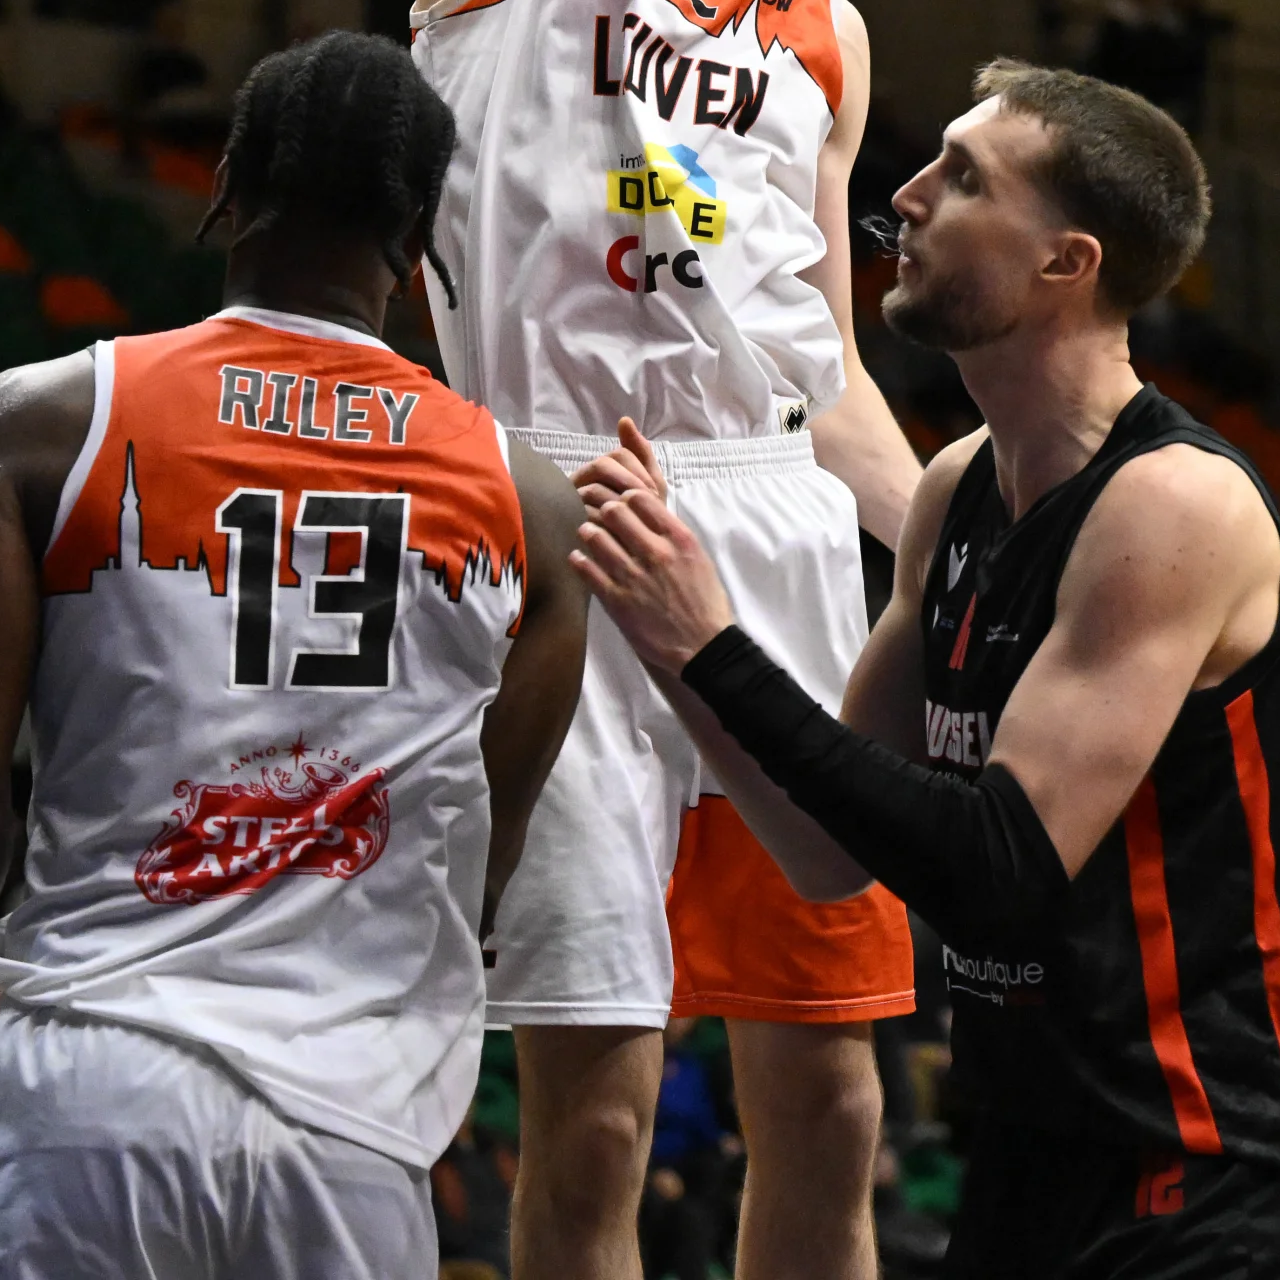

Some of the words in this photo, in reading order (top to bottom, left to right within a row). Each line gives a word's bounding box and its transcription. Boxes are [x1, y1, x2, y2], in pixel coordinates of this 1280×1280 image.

[218, 364, 420, 445] RILEY
[215, 487, 411, 691] 13
[229, 745, 278, 775] ANNO
[320, 747, 361, 773] 1366
